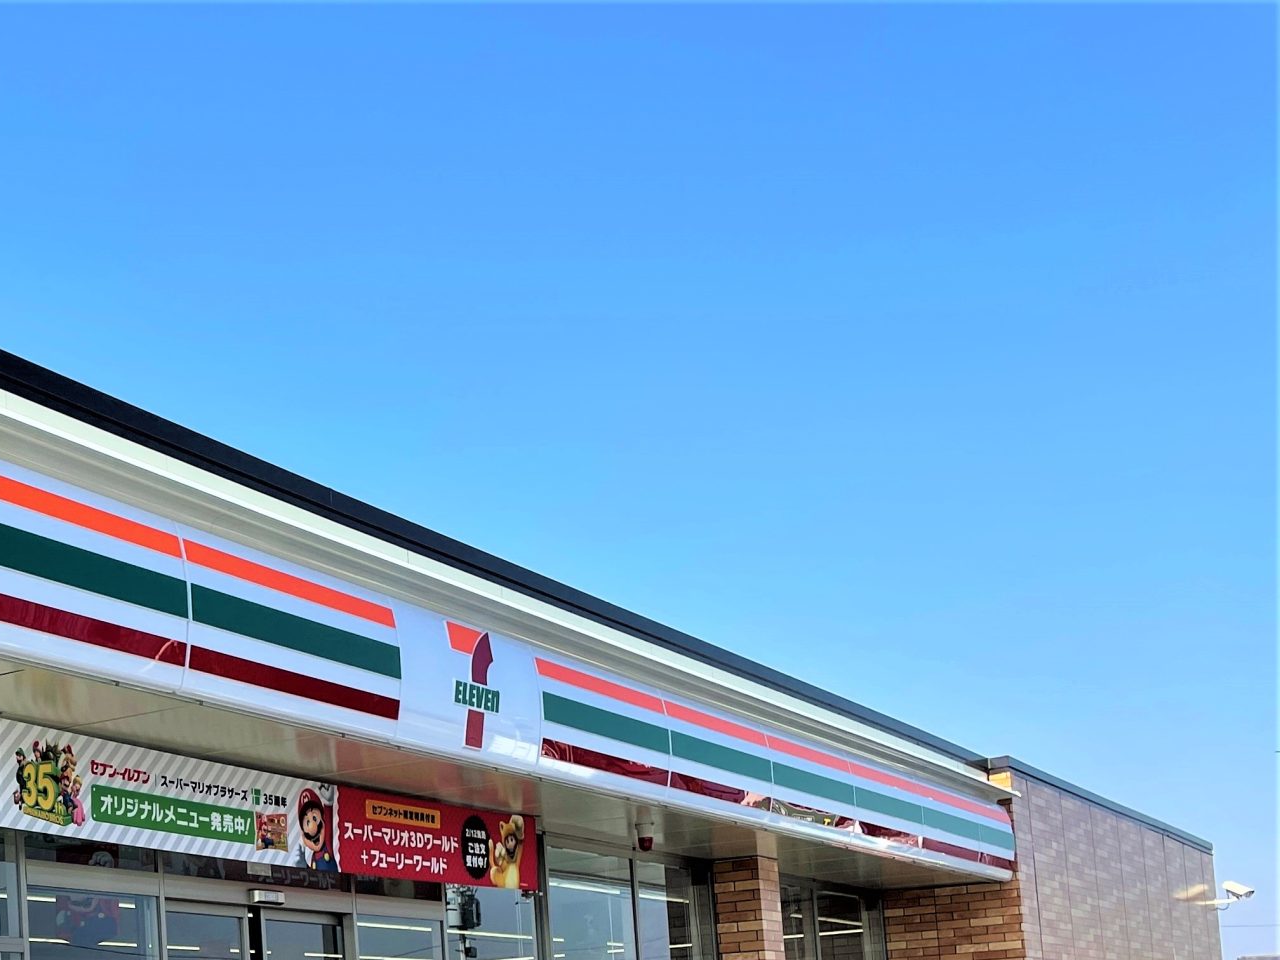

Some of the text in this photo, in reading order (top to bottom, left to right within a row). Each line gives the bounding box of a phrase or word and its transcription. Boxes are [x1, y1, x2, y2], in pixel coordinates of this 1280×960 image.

[454, 679, 500, 714] ELEVEN
[160, 775, 248, 802] スーパーマリオブラザーズ
[343, 821, 459, 854] スーパーマリオ3Dワールド
